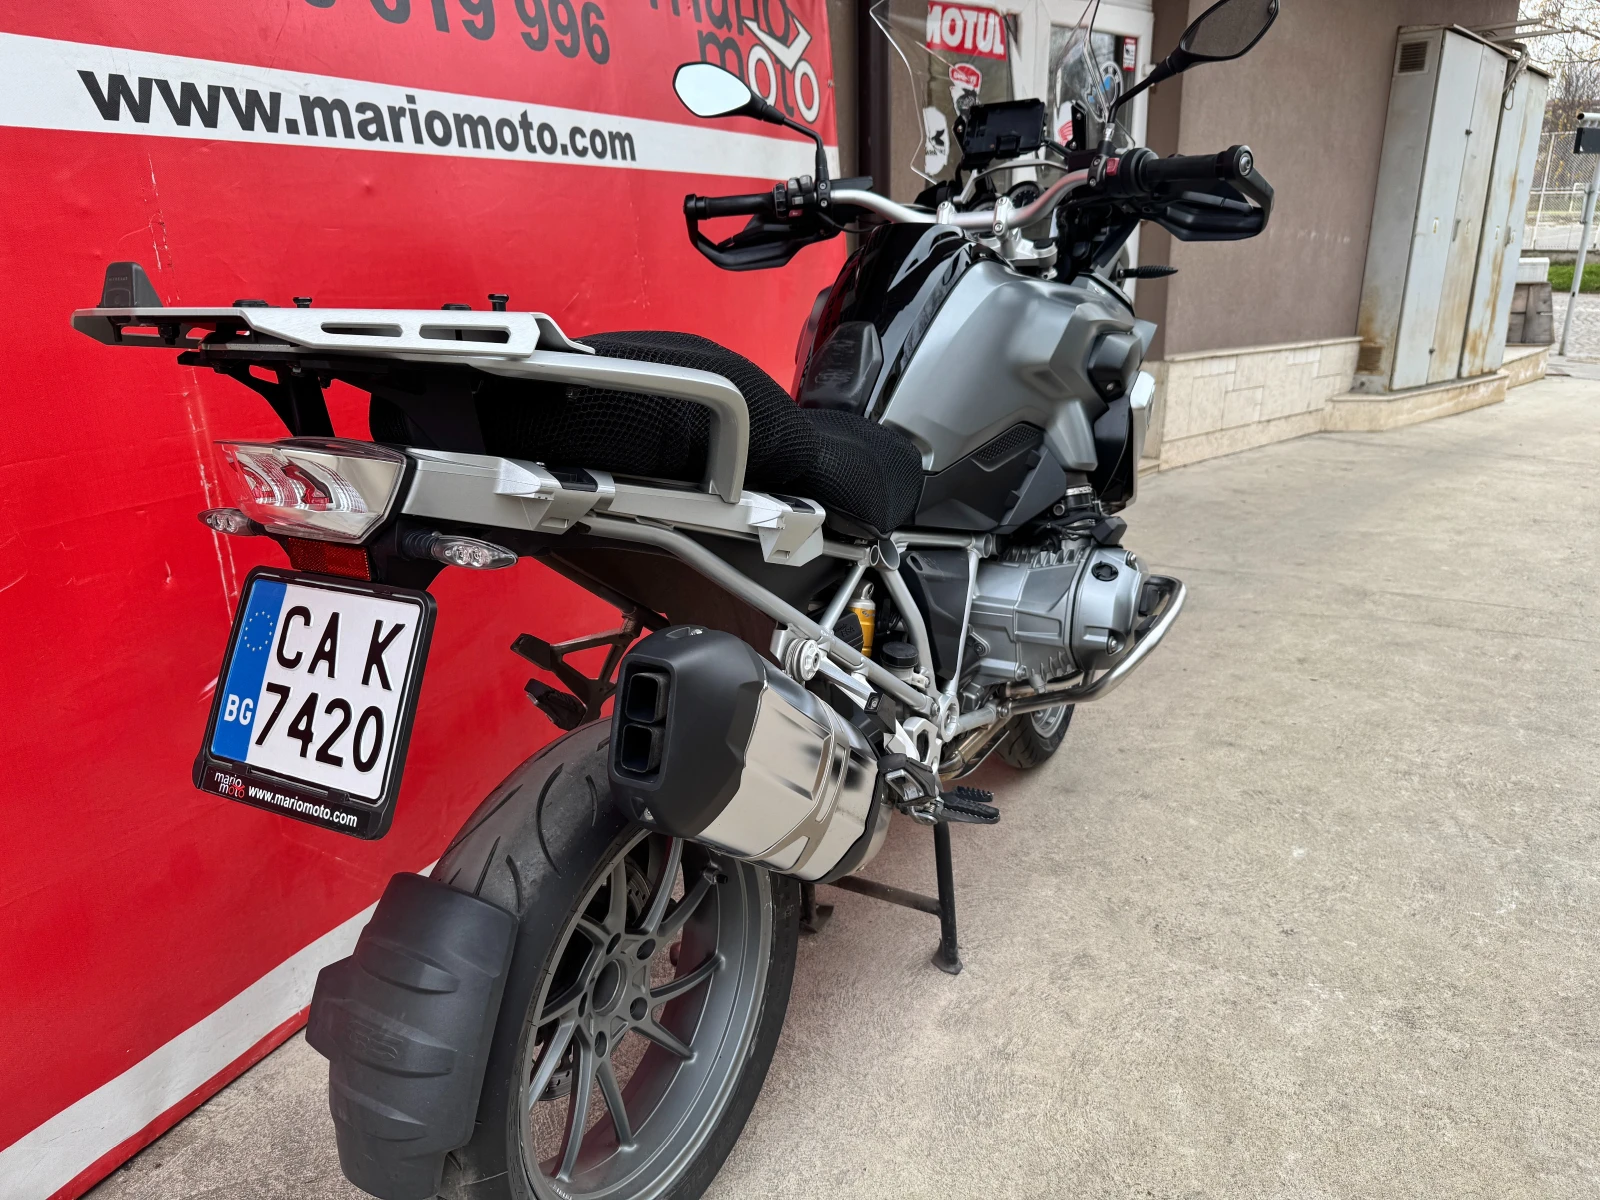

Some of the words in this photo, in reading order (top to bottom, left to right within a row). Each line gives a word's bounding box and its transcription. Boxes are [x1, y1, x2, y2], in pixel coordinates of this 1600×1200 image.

[514, 0, 610, 65] 996
[926, 5, 1004, 55] MOTUL
[697, 30, 820, 124] moto
[78, 69, 637, 163] www.mariomoto.com
[277, 605, 340, 679] CA
[361, 619, 406, 691] K
[224, 694, 253, 726] BG
[255, 682, 385, 773] 7420
[214, 772, 242, 787] mario
[218, 782, 245, 798] moto
[248, 785, 358, 828] www.mariomoto.com
